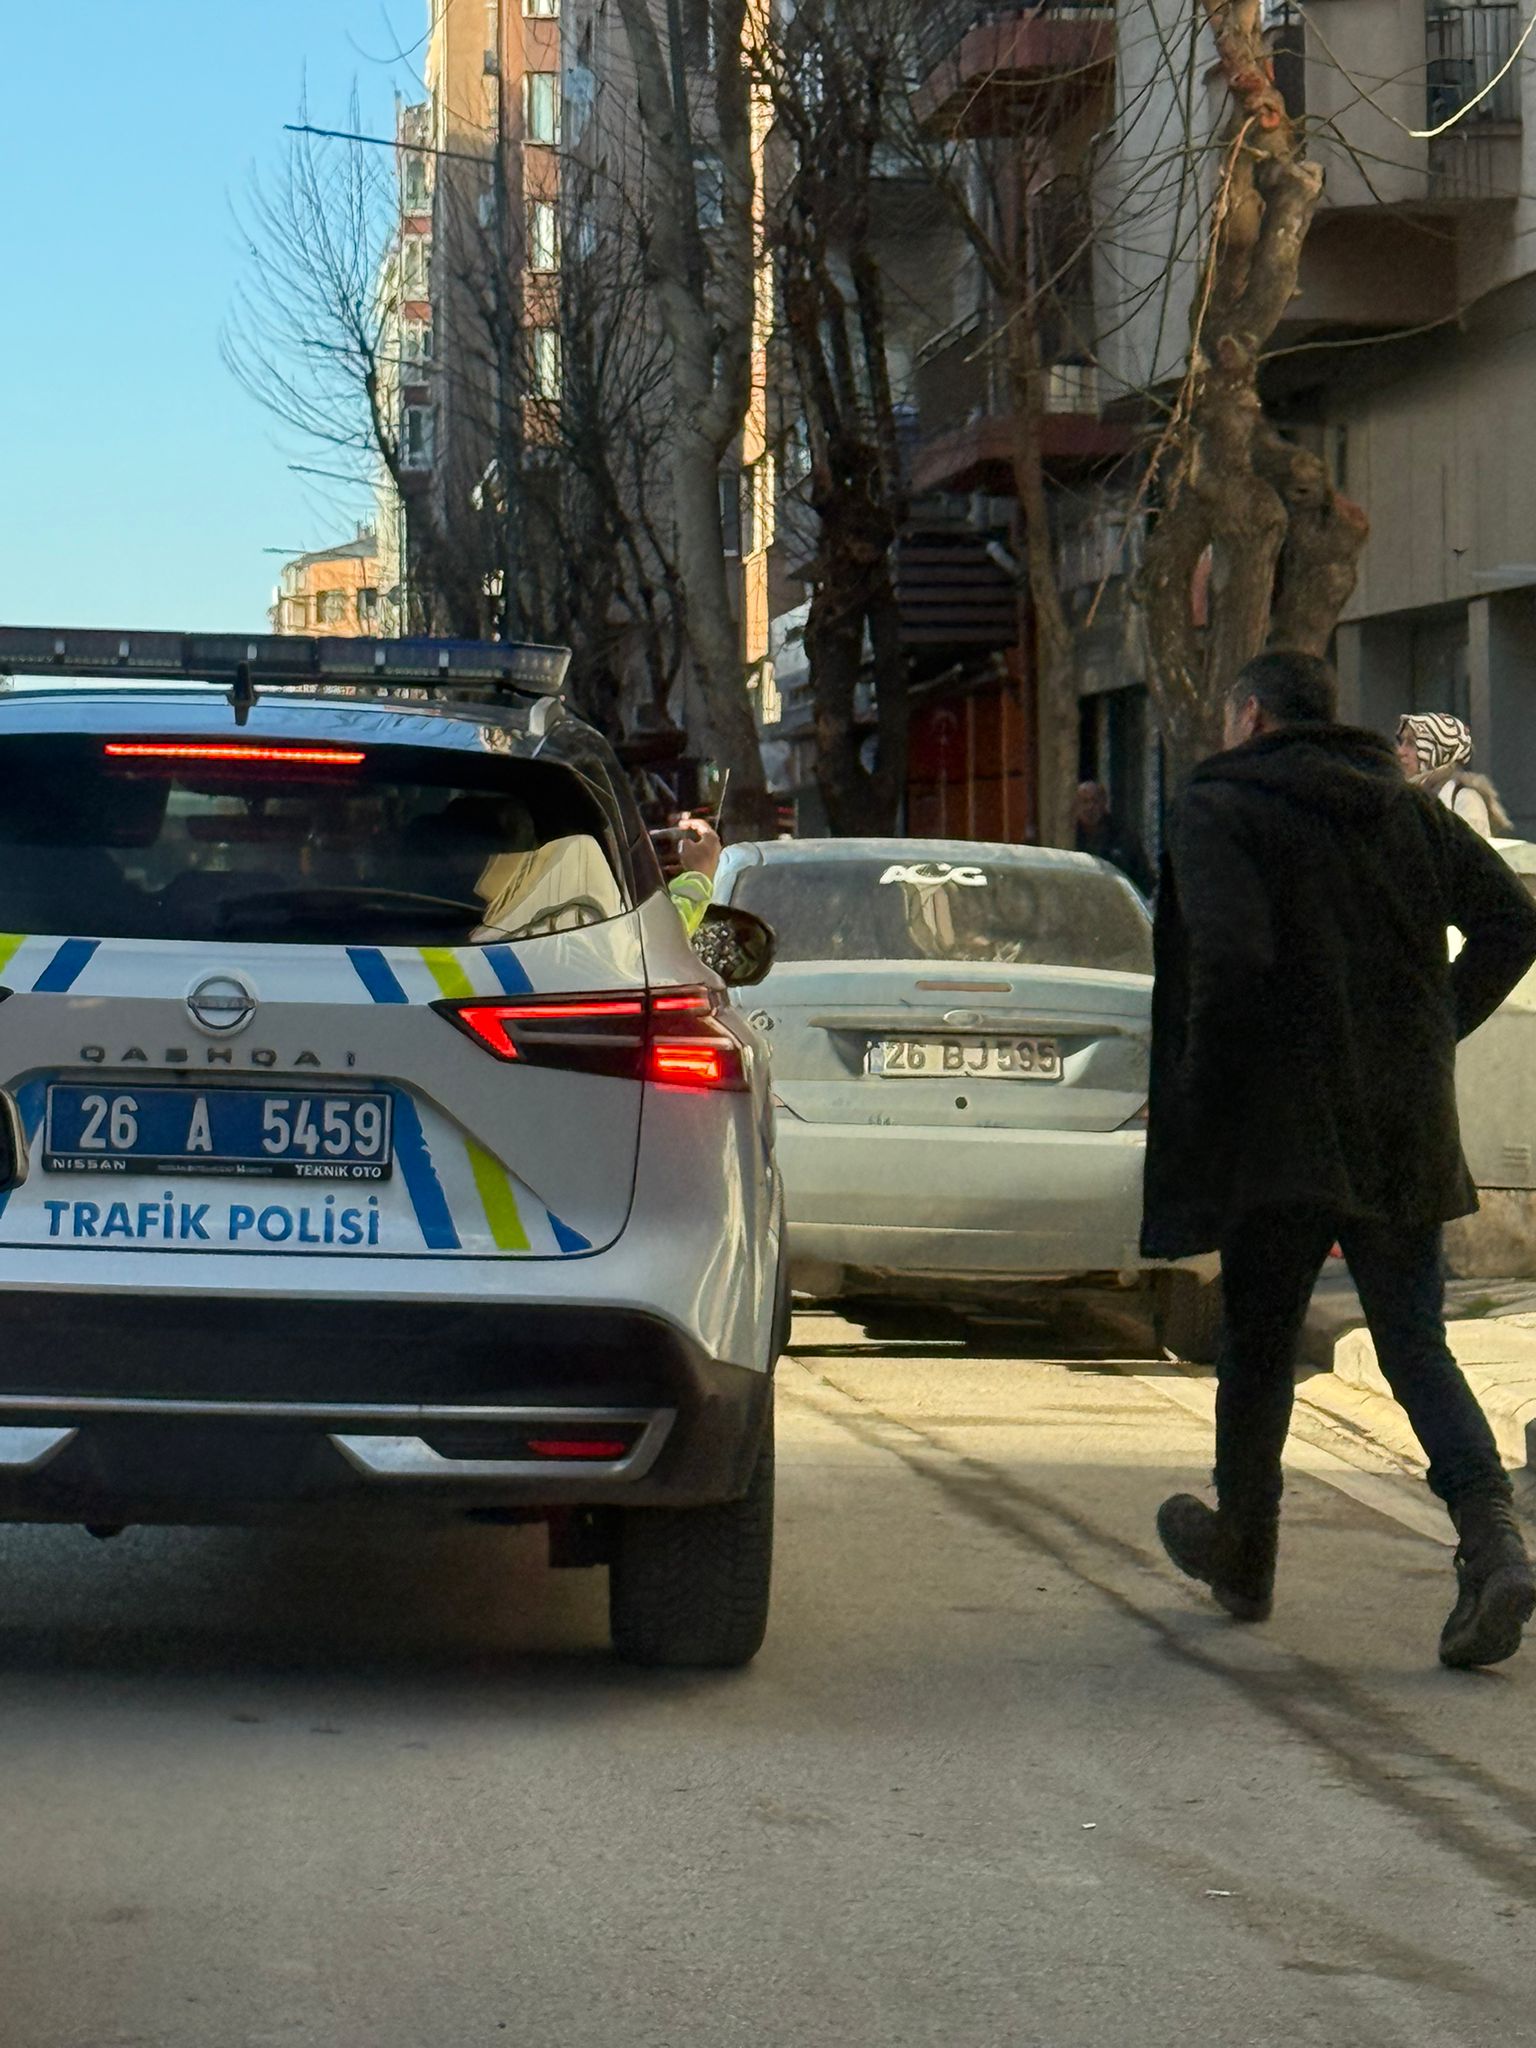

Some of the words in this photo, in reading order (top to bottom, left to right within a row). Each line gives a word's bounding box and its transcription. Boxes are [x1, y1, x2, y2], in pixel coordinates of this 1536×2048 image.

[886, 1041, 926, 1069] 26
[943, 1040, 989, 1071] BJ
[79, 1095, 138, 1149] 26
[186, 1097, 213, 1151] A
[262, 1099, 382, 1155] 5459
[52, 1158, 126, 1170] NISSAN
[352, 1166, 382, 1178] OTO
[44, 1190, 211, 1239] TRAFİK
[228, 1194, 380, 1245] POLİSİ
